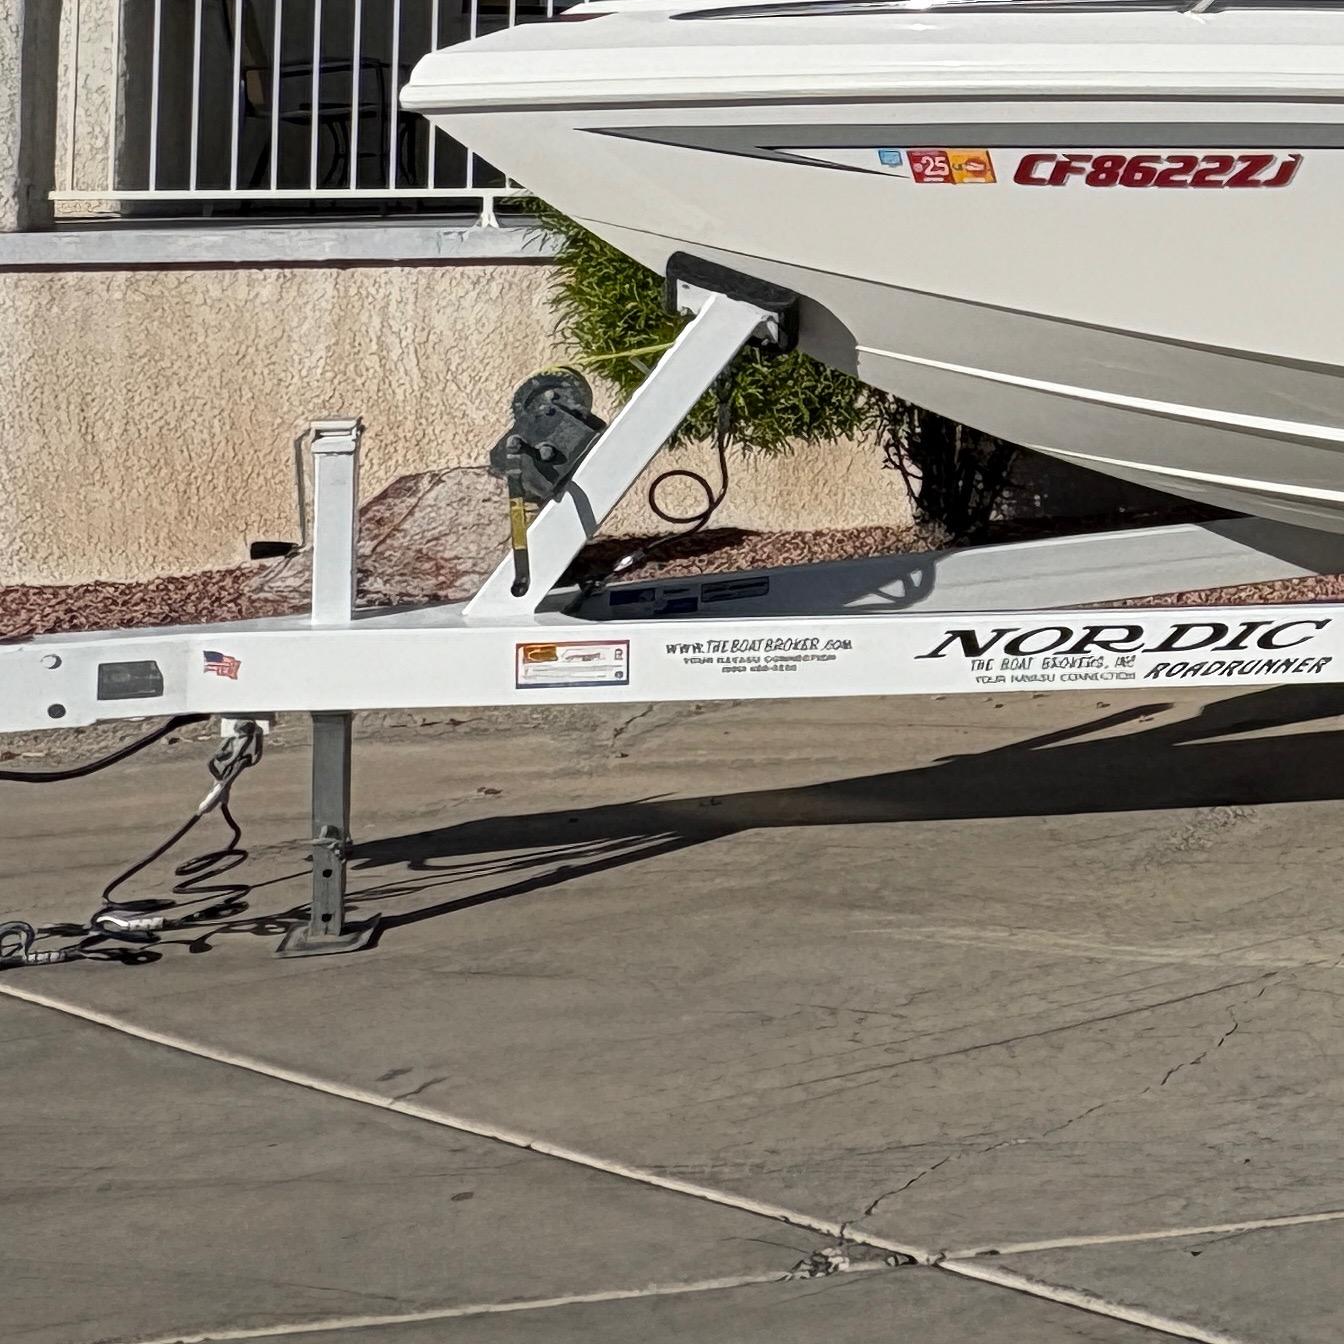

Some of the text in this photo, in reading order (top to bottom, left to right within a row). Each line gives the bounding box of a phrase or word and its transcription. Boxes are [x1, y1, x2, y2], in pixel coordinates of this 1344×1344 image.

[920, 155, 950, 176] 25
[914, 619, 1332, 659] NORDIC
[971, 658, 995, 671] THE
[1000, 657, 1035, 670] BOAT
[1143, 656, 1333, 680] ROADRUNNER
